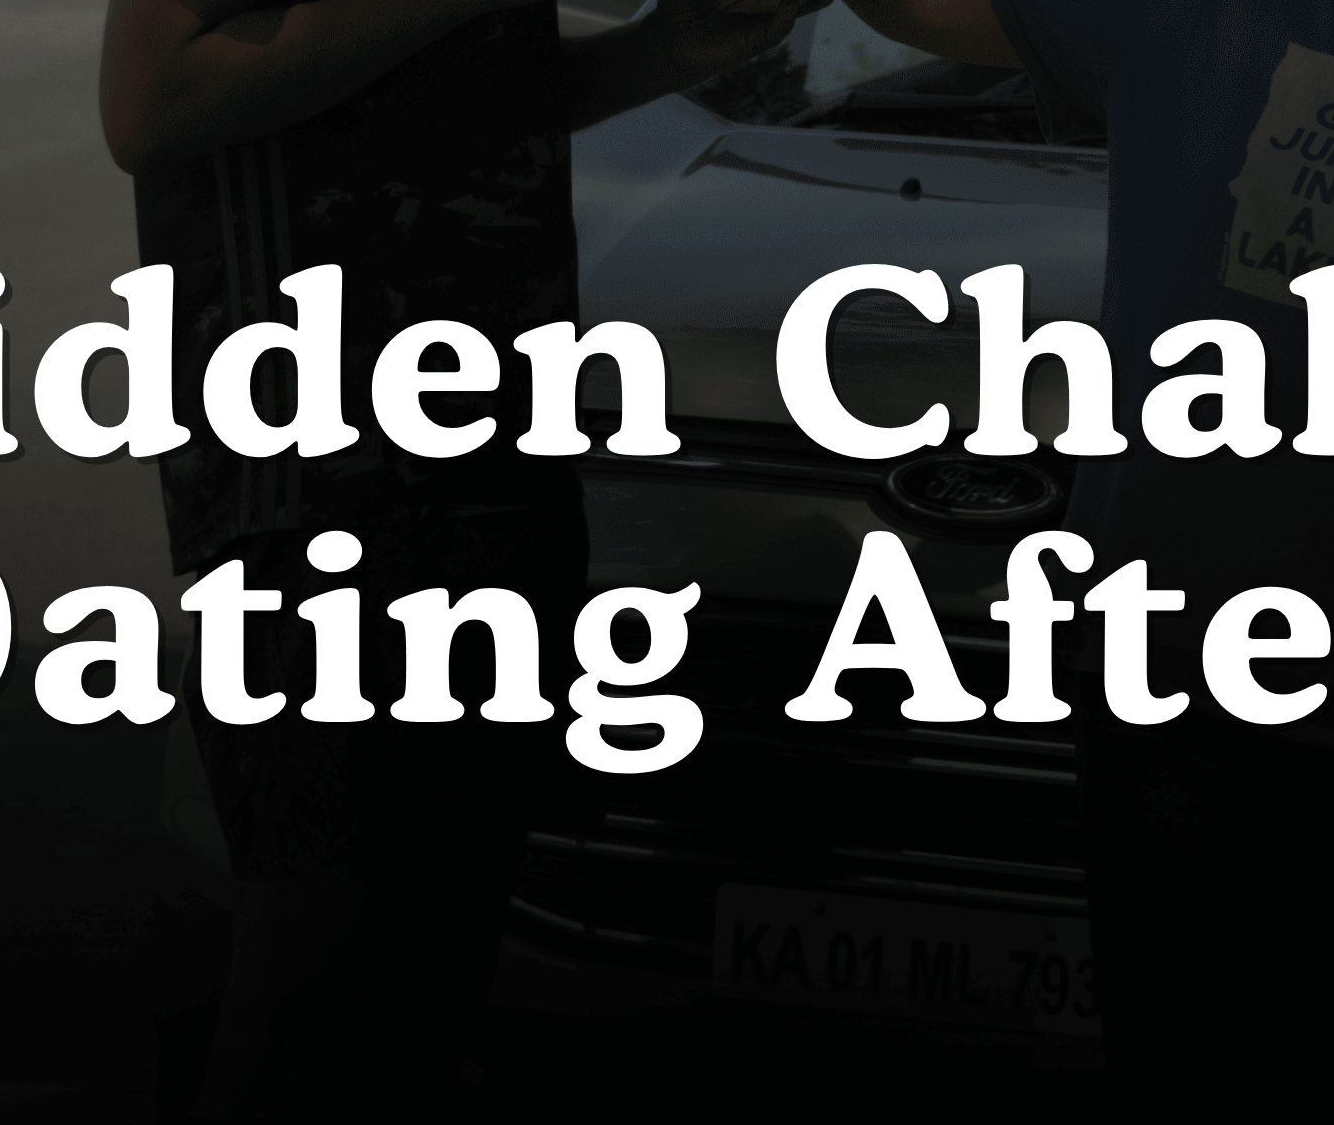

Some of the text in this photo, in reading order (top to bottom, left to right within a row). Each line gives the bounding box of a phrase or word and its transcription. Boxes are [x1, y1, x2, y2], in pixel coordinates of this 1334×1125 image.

[1286, 207, 1314, 242] A
[925, 463, 1019, 505] Ford
[732, 920, 809, 989] KA
[827, 931, 883, 996] 01
[909, 940, 989, 1008] ML
